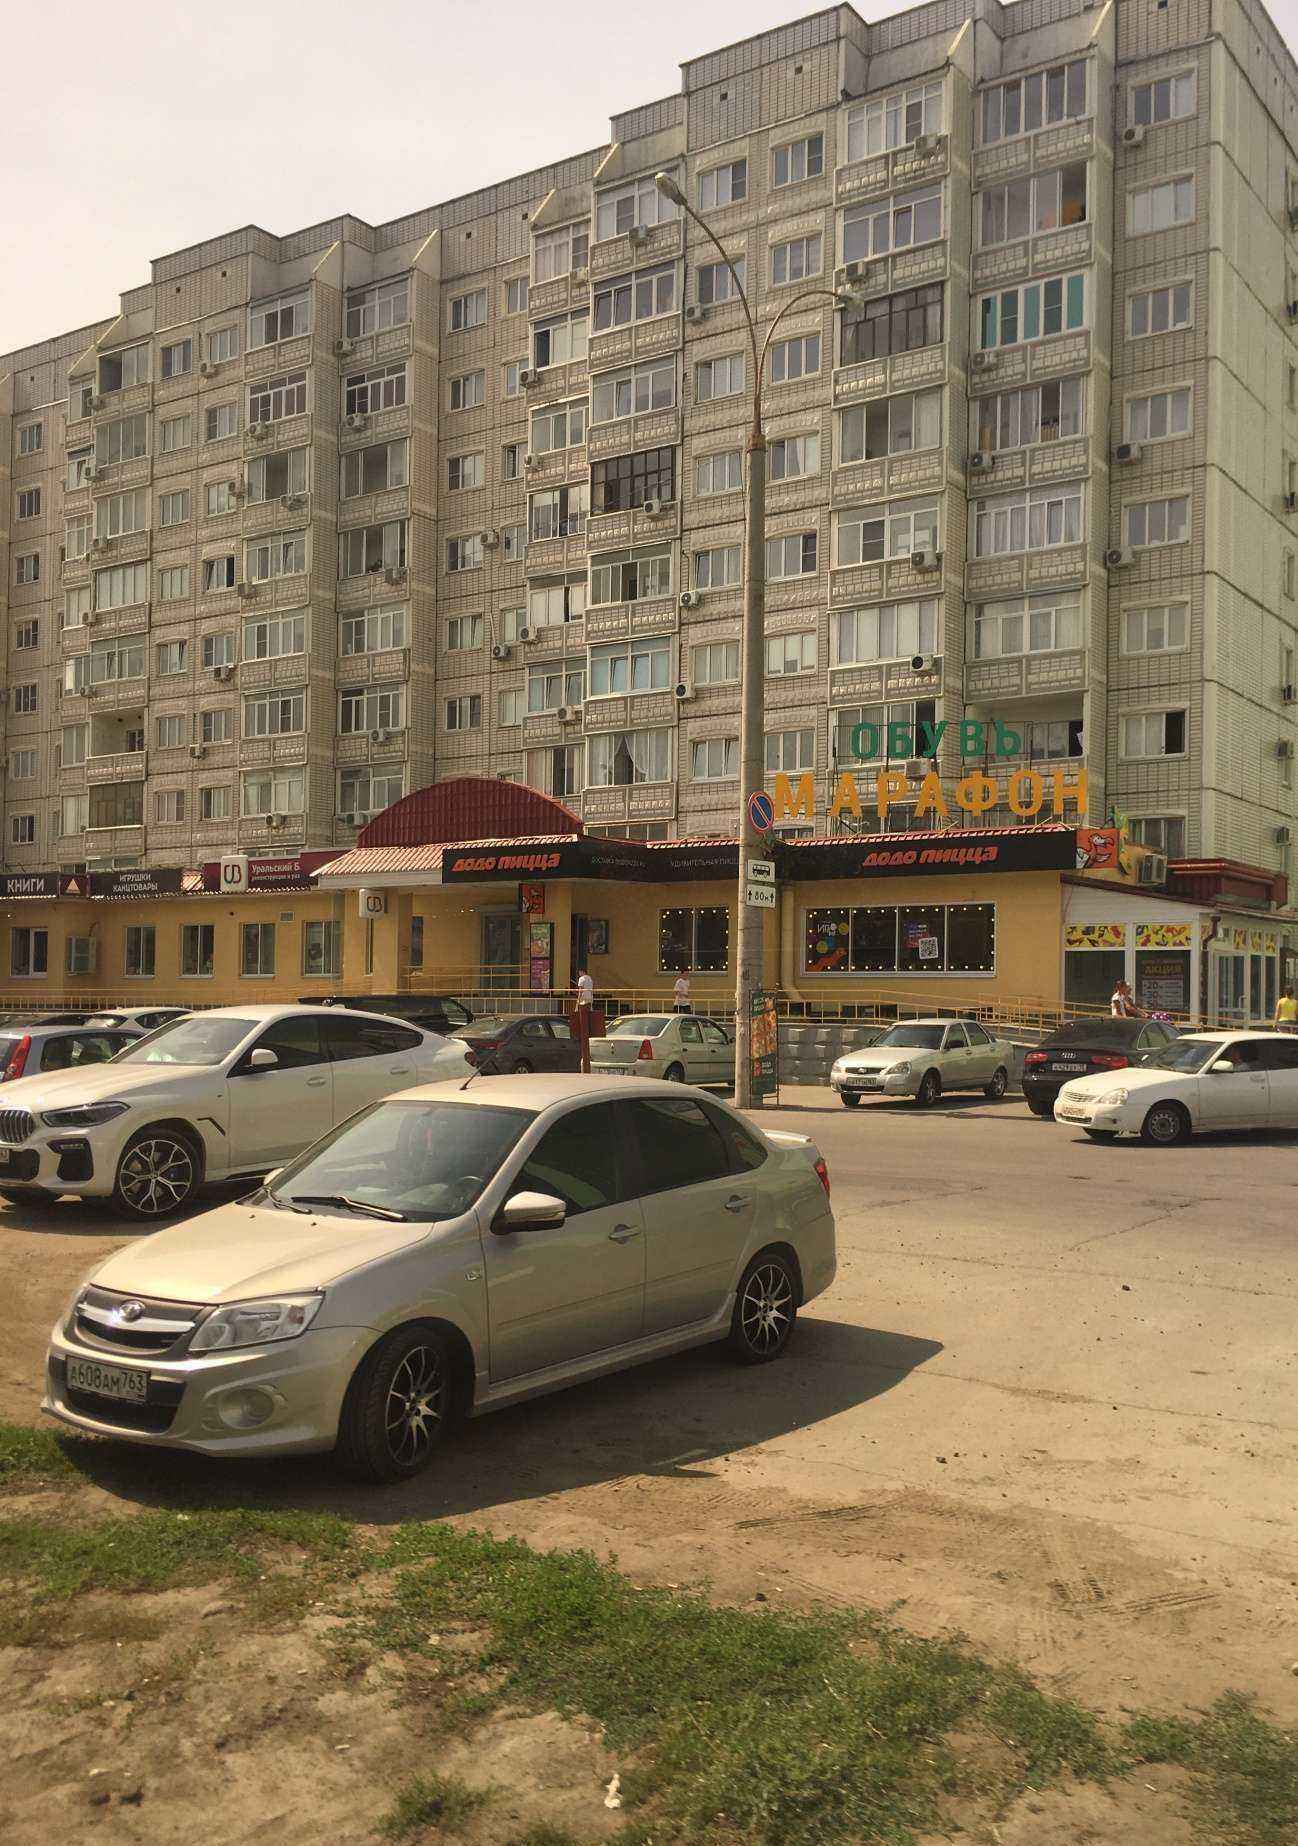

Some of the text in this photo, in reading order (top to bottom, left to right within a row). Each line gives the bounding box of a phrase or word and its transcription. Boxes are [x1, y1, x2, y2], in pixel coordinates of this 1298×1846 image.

[851, 720, 1020, 759] ОБУВЬ
[774, 768, 1087, 817] МАРАФОН
[251, 863, 292, 875] Уральский
[119, 873, 151, 882] ИГРУШКИ
[7, 878, 45, 893] КНИГИ
[113, 883, 158, 893] КАНЦТОВАРЫ
